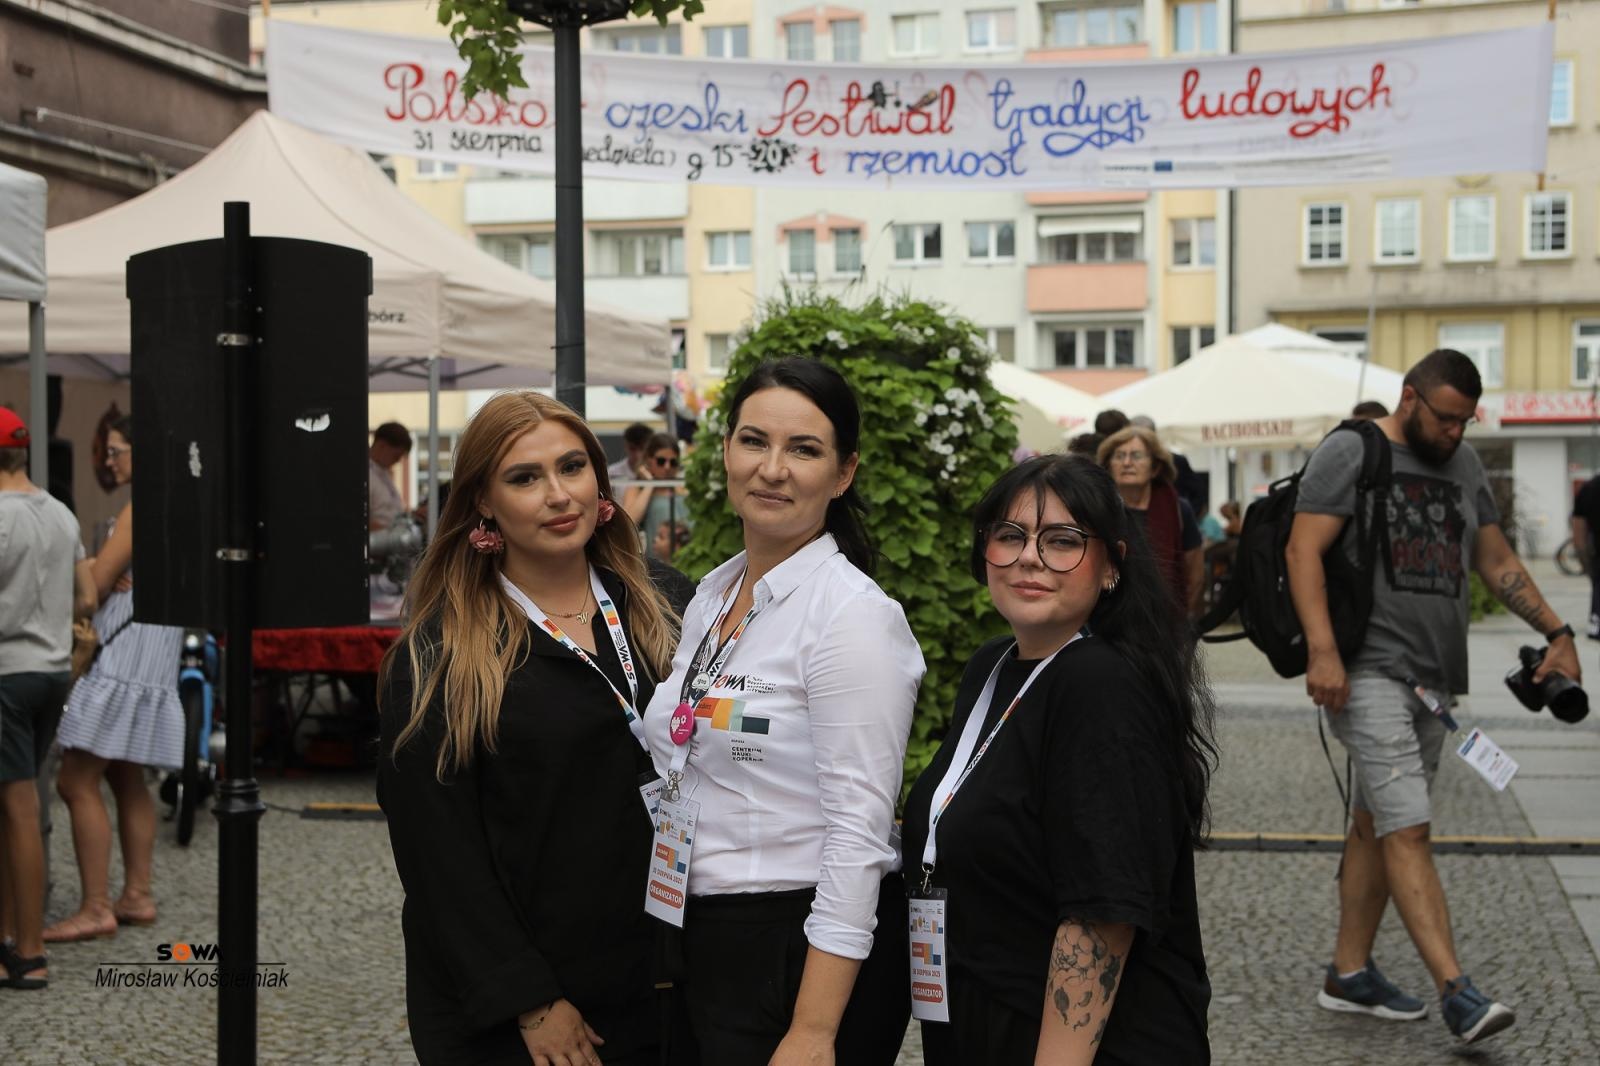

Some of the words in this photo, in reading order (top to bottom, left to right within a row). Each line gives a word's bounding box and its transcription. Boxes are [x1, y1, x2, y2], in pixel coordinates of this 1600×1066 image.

[605, 82, 749, 143] czeski
[988, 78, 1150, 157] tradycji
[1180, 63, 1392, 138] ludowych
[414, 129, 433, 150] 31
[451, 130, 543, 158] sierpnia
[687, 152, 703, 180] g
[809, 148, 825, 175] i
[847, 127, 1028, 178] rzemiosł
[650, 884, 683, 905] ORGANIZATOR
